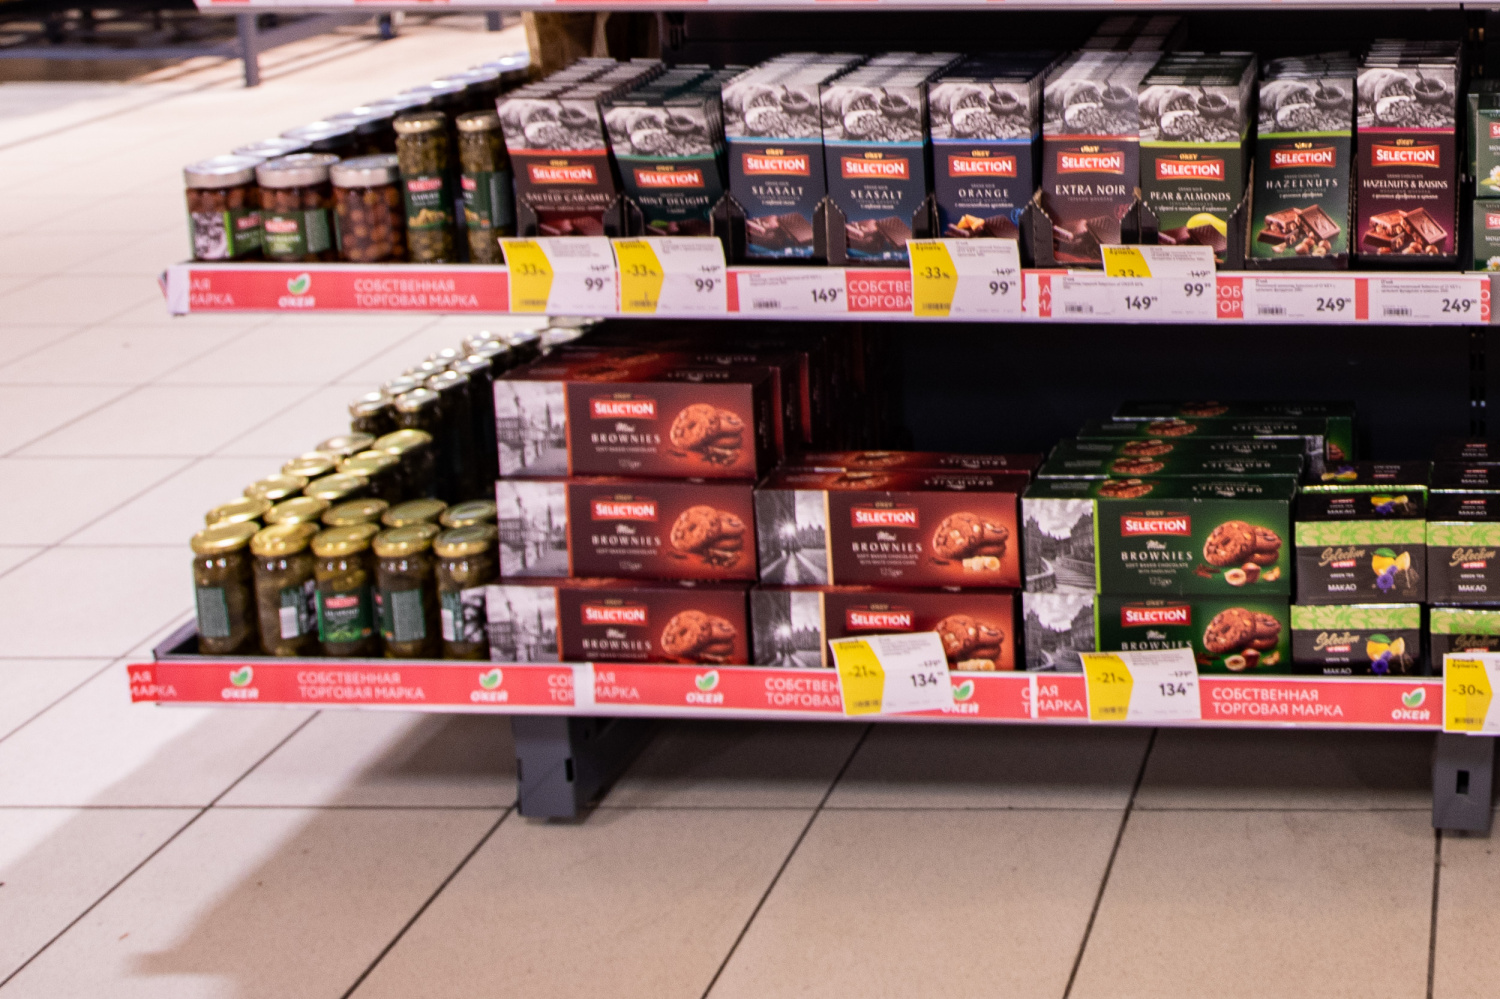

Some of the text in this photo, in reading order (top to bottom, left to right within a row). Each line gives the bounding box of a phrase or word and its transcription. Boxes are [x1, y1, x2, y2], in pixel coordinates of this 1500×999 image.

[1376, 148, 1436, 163] SELECTION
[1061, 156, 1121, 170] SELECTION
[533, 167, 593, 182] SELECTION
[1266, 178, 1338, 189] HAZELNUTS
[1363, 179, 1448, 189] HAZELNUTS & RAISINS
[751, 186, 804, 197] SEASALT
[850, 189, 903, 200] SEASALT
[1056, 184, 1126, 195] EXTRA NOIR
[1150, 191, 1231, 201] PEAR & ALMONDS
[591, 434, 661, 443] BROWNIES
[594, 504, 654, 518] SELECTION
[1125, 518, 1187, 533] SELECTION
[1121, 551, 1193, 561] BROWNIES
[582, 640, 652, 650] BROWNIES
[1212, 687, 1320, 701] СОБСТВЕННАЯ
[1212, 701, 1343, 717] ТОРГОВАЯ МАРКА
